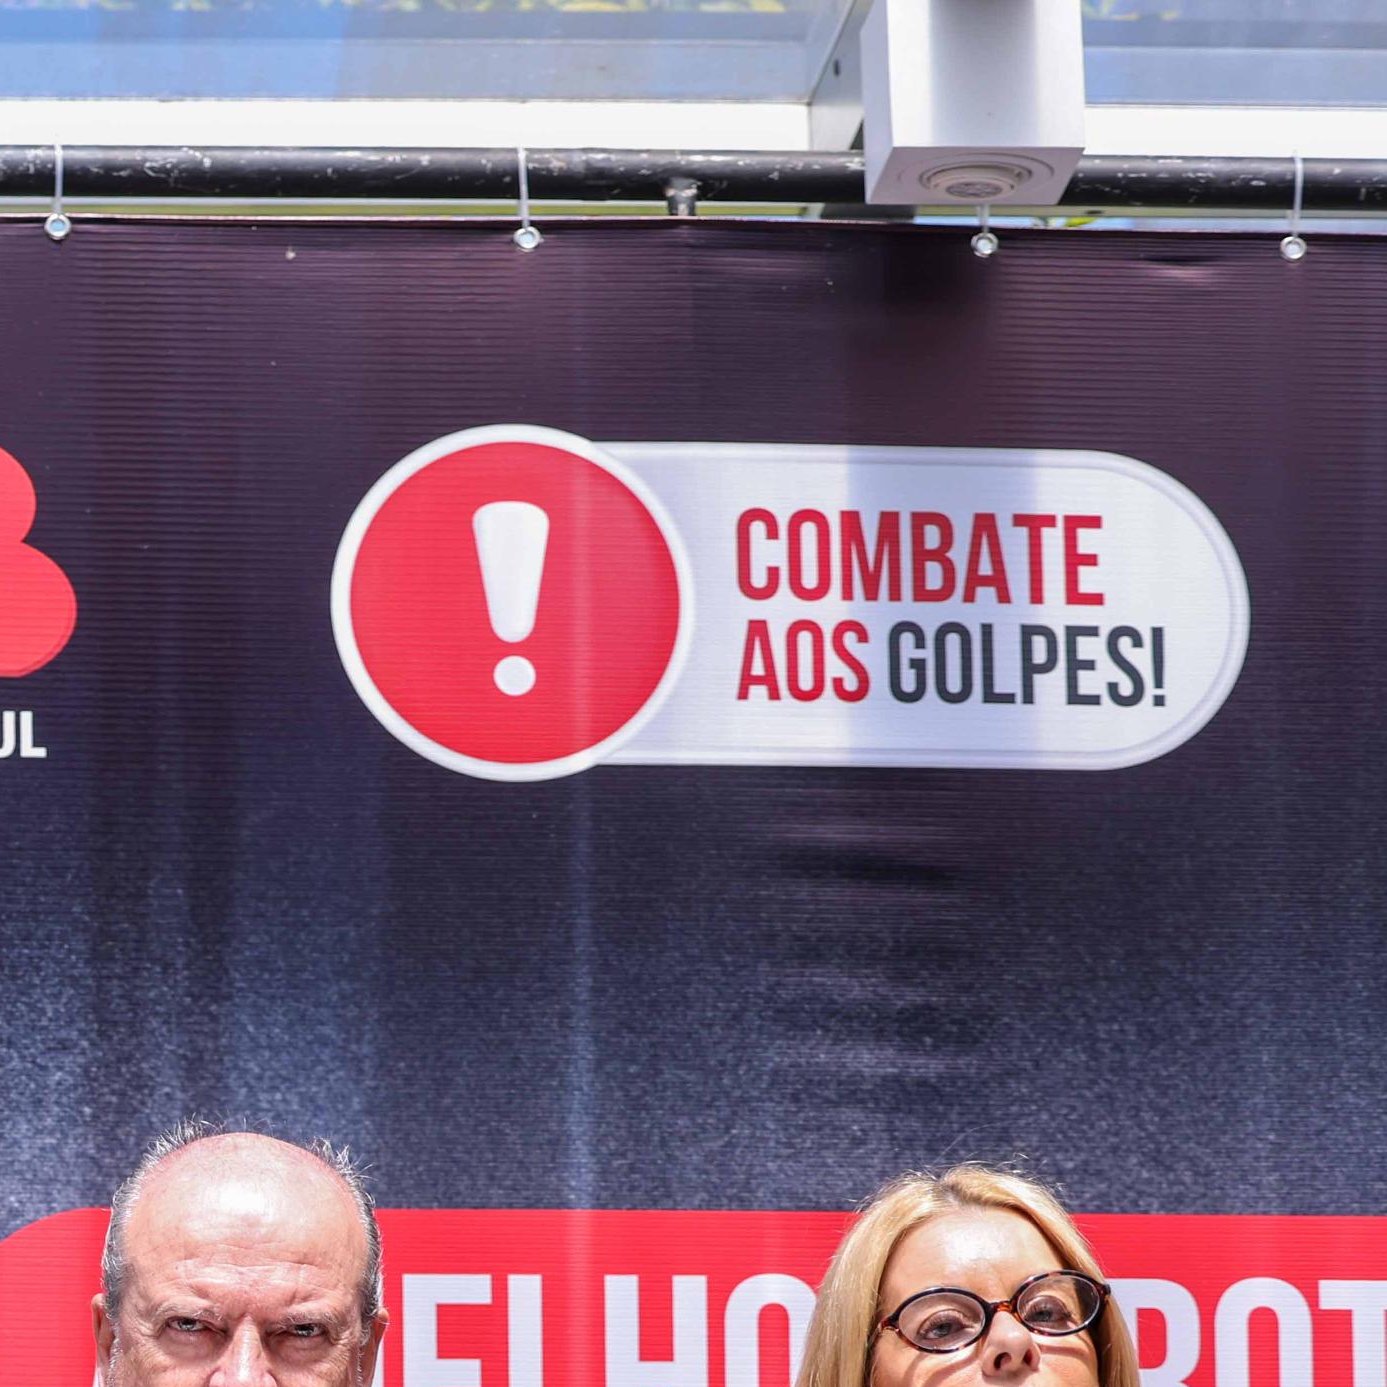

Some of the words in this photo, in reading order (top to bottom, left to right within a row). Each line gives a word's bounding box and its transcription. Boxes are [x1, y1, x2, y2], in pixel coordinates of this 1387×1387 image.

[735, 507, 1105, 607] COMBATE
[736, 618, 871, 704] AOS
[887, 620, 1168, 707] GOLPES!
